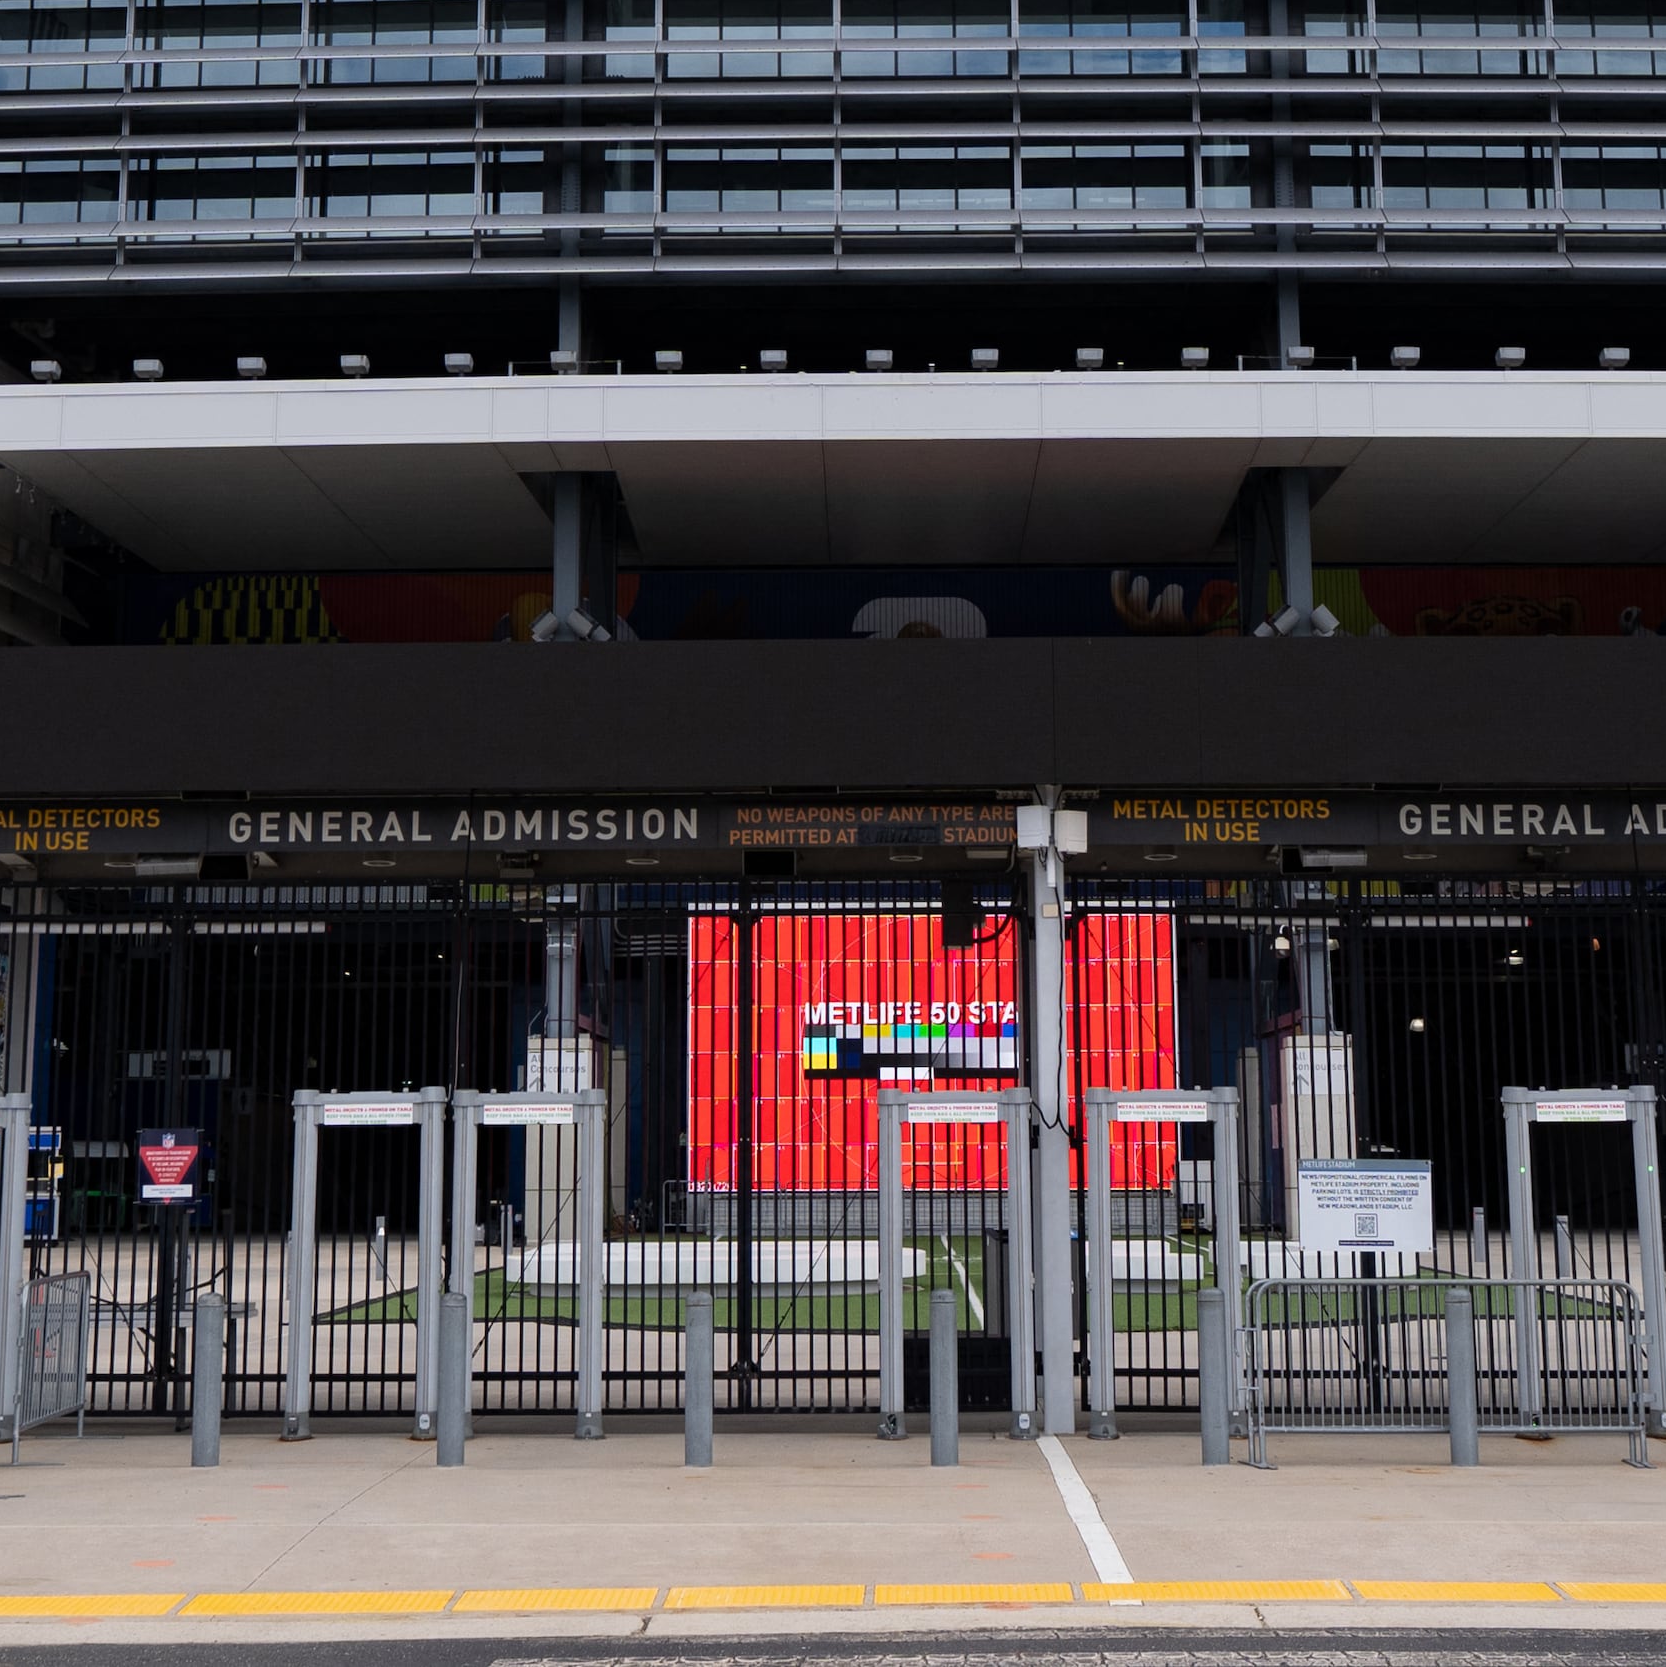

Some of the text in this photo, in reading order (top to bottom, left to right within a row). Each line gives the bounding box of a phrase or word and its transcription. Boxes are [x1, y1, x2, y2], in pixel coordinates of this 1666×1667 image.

[29, 809, 160, 828] DETECTORS
[736, 805, 1013, 823] NO WEAPONS OF ANY TYPE ARE
[1113, 800, 1329, 818] METAL DETECTORS
[229, 808, 697, 843] GENERAL ADMISSION
[1400, 803, 1605, 836] GENERAL
[15, 832, 89, 850] IN USE
[729, 829, 831, 844] PERMITTED
[836, 829, 855, 843] AT
[1185, 822, 1259, 841] IN USE
[805, 1002, 921, 1024] METLIFE
[931, 1002, 960, 1024] 50
